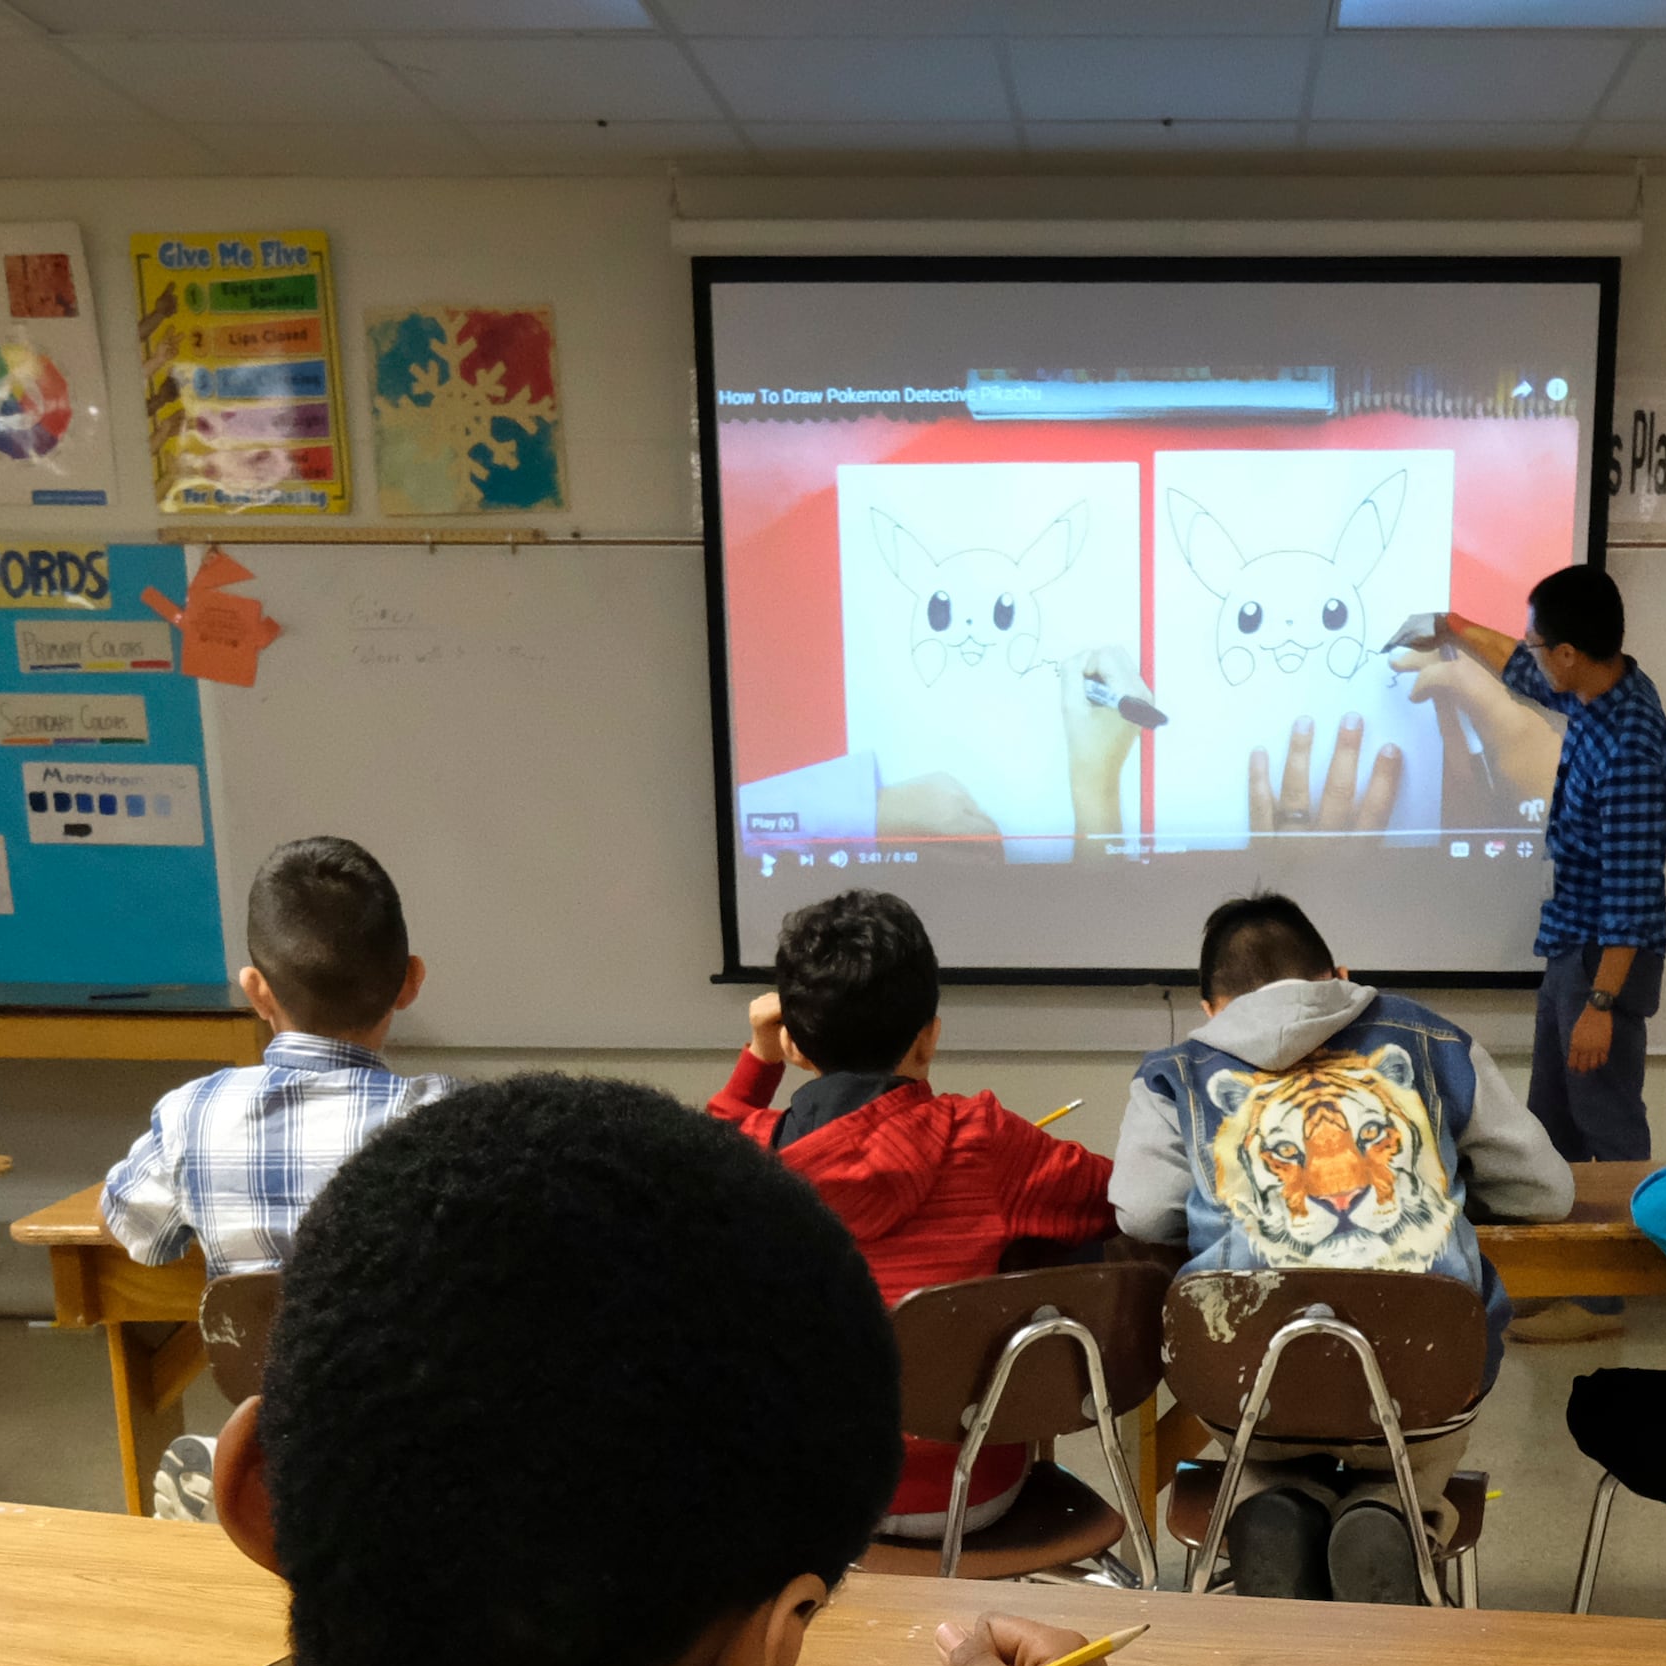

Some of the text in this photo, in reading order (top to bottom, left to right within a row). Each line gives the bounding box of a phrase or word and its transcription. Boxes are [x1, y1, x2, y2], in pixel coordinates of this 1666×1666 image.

[158, 241, 309, 269] Give Me Five
[718, 386, 1042, 405] How To Draw Pokemon Detective Pikachu
[750, 817, 776, 830] Play
